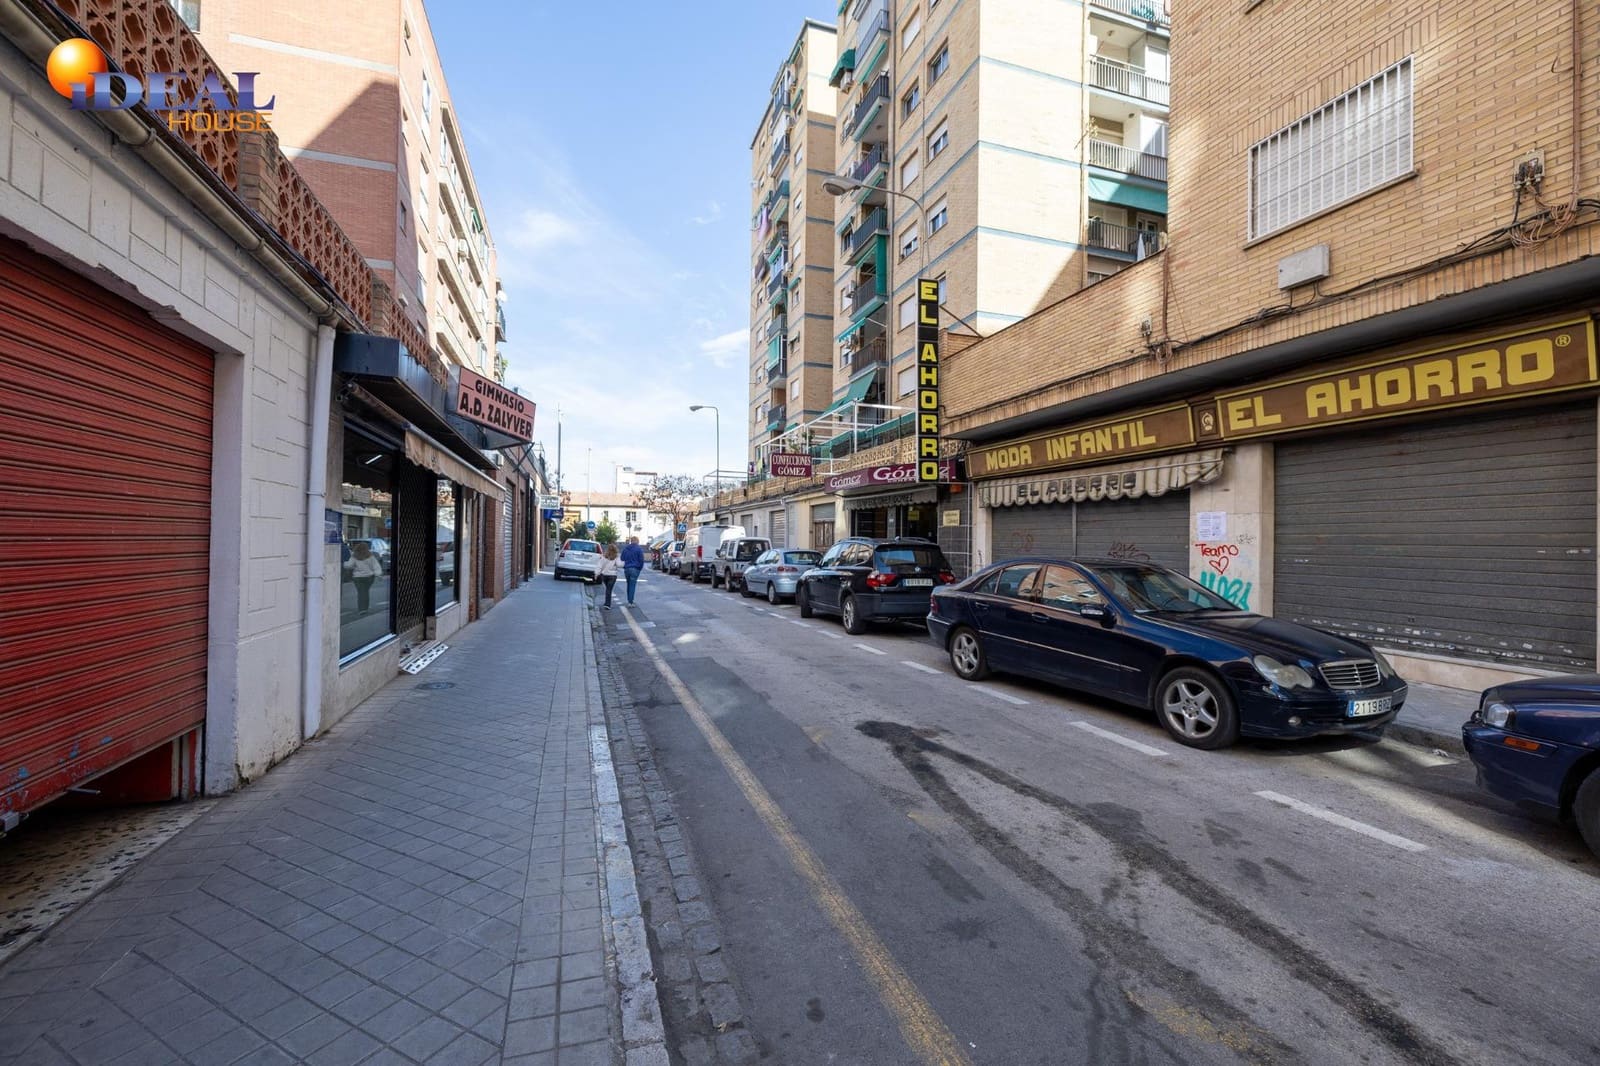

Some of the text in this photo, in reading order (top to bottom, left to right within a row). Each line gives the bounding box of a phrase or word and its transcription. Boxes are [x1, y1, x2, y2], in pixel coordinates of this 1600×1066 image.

[475, 380, 524, 413] GIMNASIO
[920, 281, 938, 481] EL AHORRO
[460, 392, 532, 439] A.D. ZALYVER
[1227, 395, 1282, 431] EL
[772, 454, 811, 466] CONFECCIONES
[985, 421, 1156, 471] MODA INFANTIL
[777, 464, 806, 476] GÓMEZ
[830, 475, 862, 488] Gómez
[1016, 472, 1137, 498] EL AHORRO
